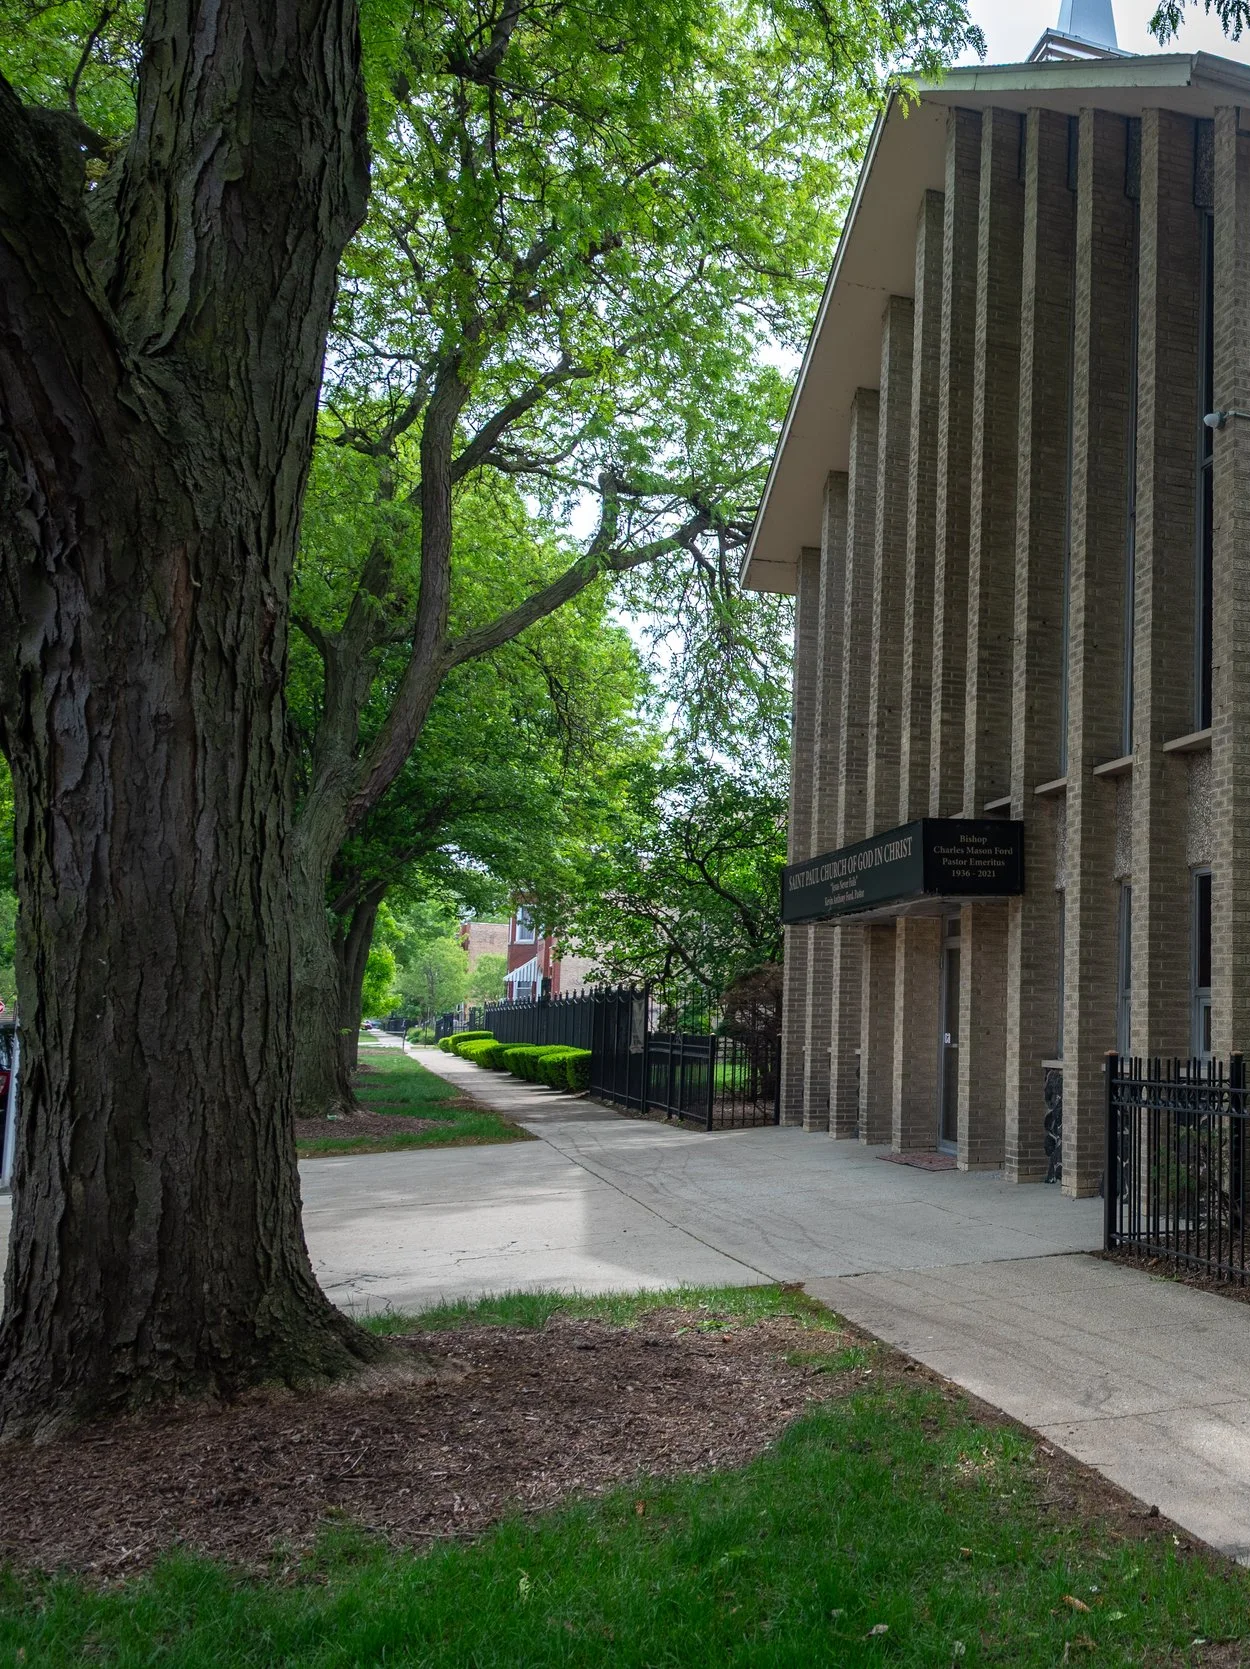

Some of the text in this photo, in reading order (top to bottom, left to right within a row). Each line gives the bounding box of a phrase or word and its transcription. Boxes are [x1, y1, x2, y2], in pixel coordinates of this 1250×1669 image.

[960, 834, 988, 845] Bishop
[933, 845, 1014, 855] Charles Mason Ford
[788, 836, 913, 891] SAINT PAUL CHURCH OF GOD IN CHRIST
[942, 857, 1006, 866] Pastor Emeritus
[952, 869, 971, 877] 1936
[977, 870, 996, 878] 2021
[839, 879, 849, 889] Never
[854, 889, 865, 899] Pastor
